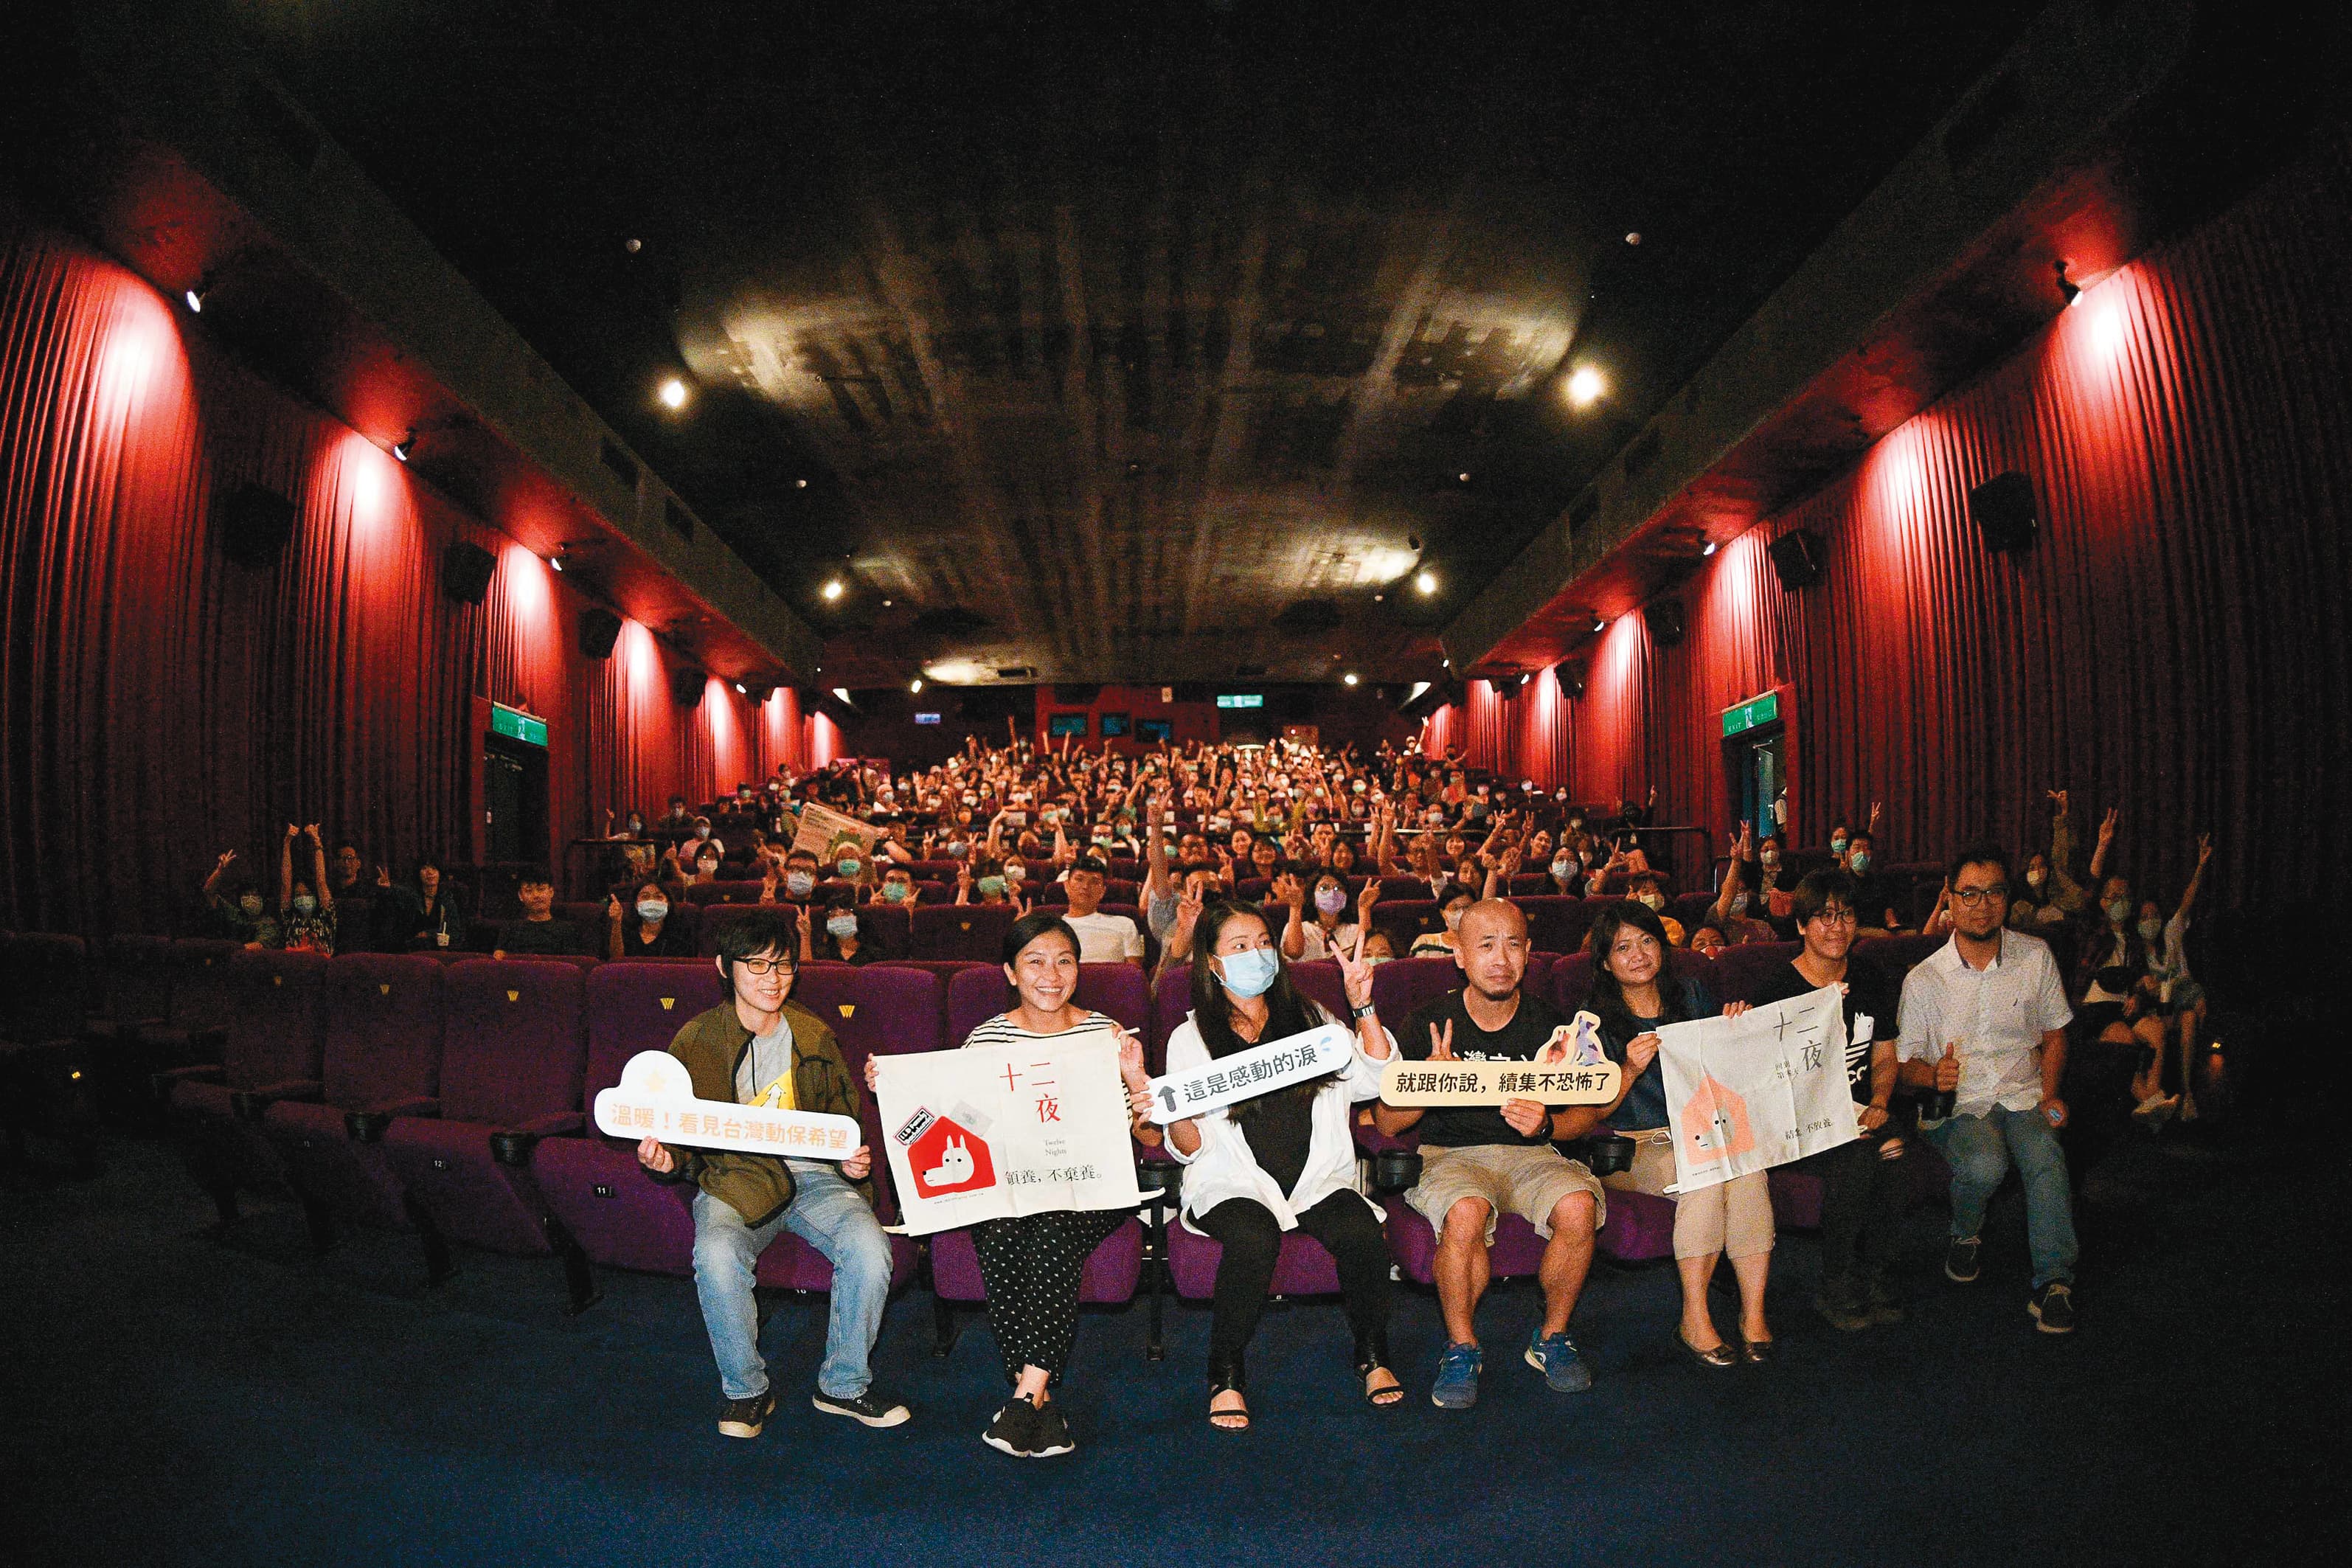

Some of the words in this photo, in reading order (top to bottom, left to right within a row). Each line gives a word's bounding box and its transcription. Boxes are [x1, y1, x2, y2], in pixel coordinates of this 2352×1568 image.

[1800, 1040, 1822, 1072] 夜
[1184, 1044, 1318, 1103] 這是感動的淚
[1396, 1072, 1610, 1094] 就跟你說，續集不恐怖了
[1035, 1093, 1061, 1124] 夜
[611, 1103, 848, 1150] 溫暖！看見台灣動保希望
[1045, 1148, 1067, 1156] Nights
